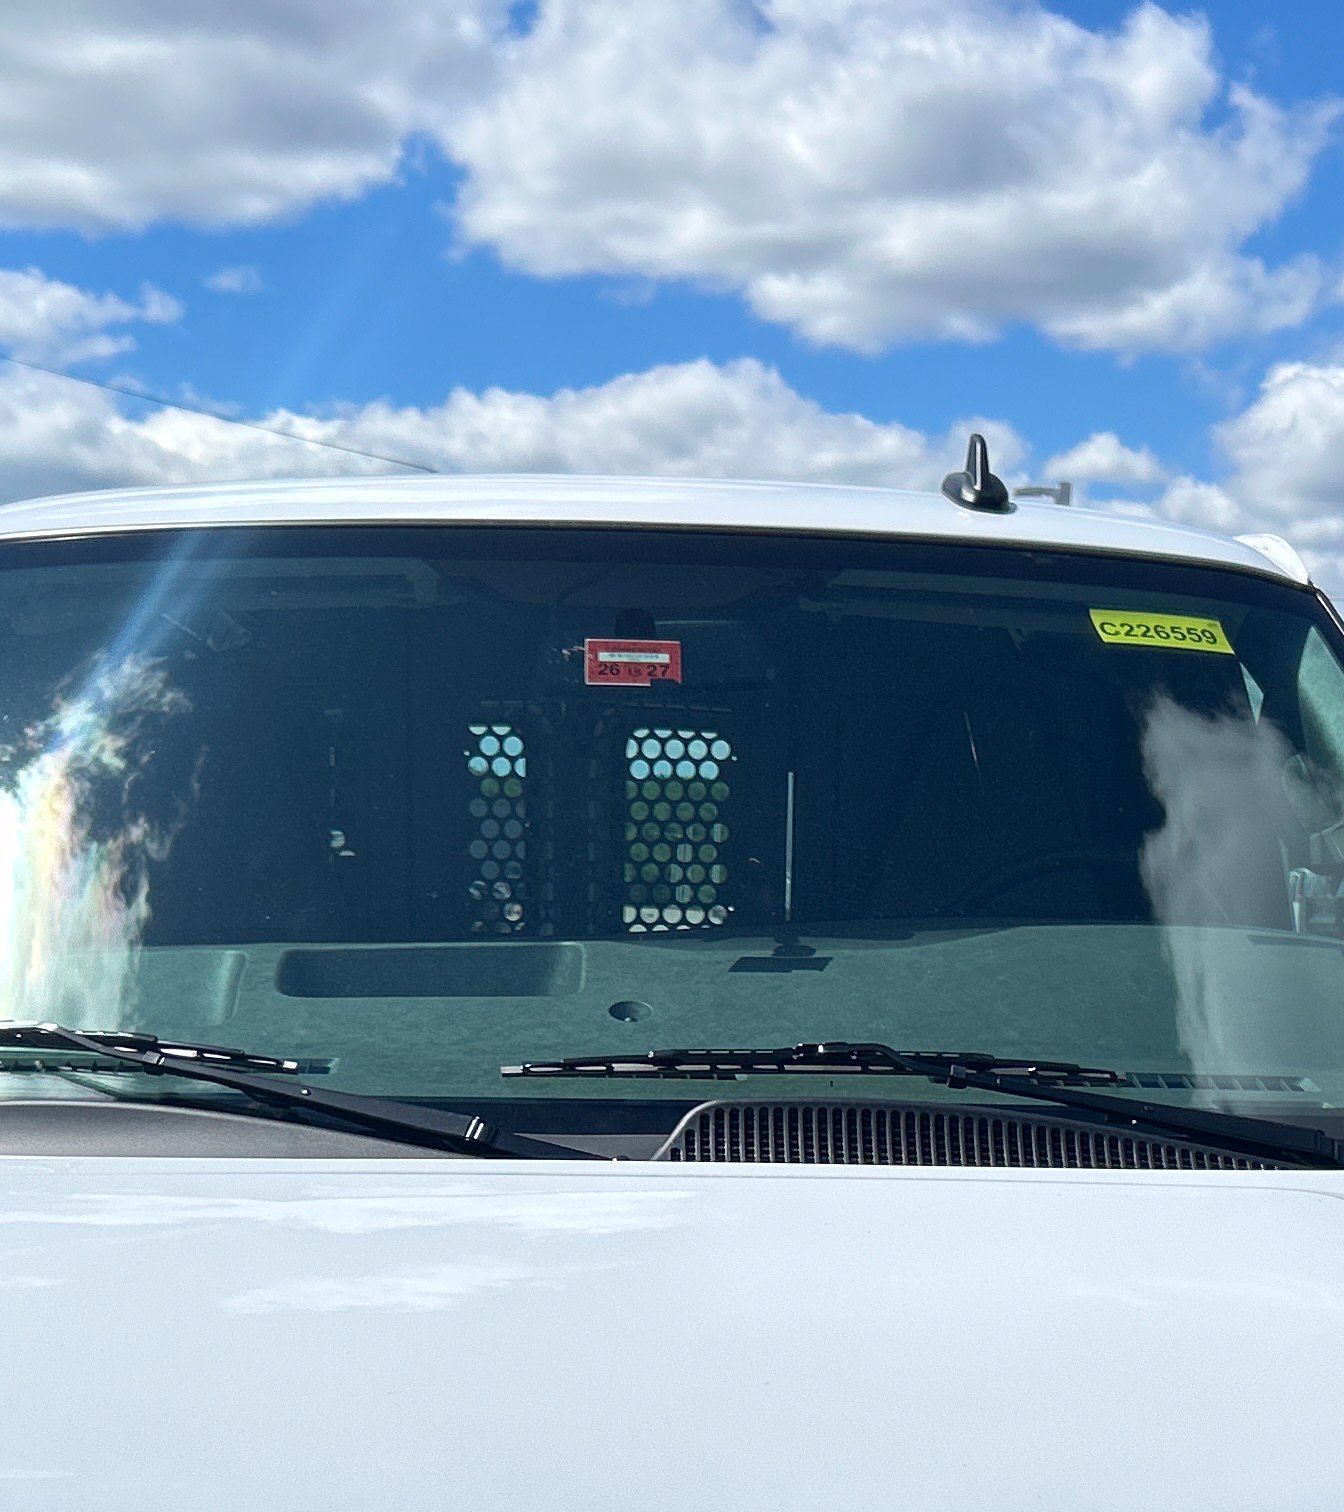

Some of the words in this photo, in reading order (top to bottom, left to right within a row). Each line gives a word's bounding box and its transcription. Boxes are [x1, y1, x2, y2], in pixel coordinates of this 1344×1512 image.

[1098, 621, 1218, 645] C226559
[598, 663, 621, 676] 26
[646, 664, 670, 677] 27
